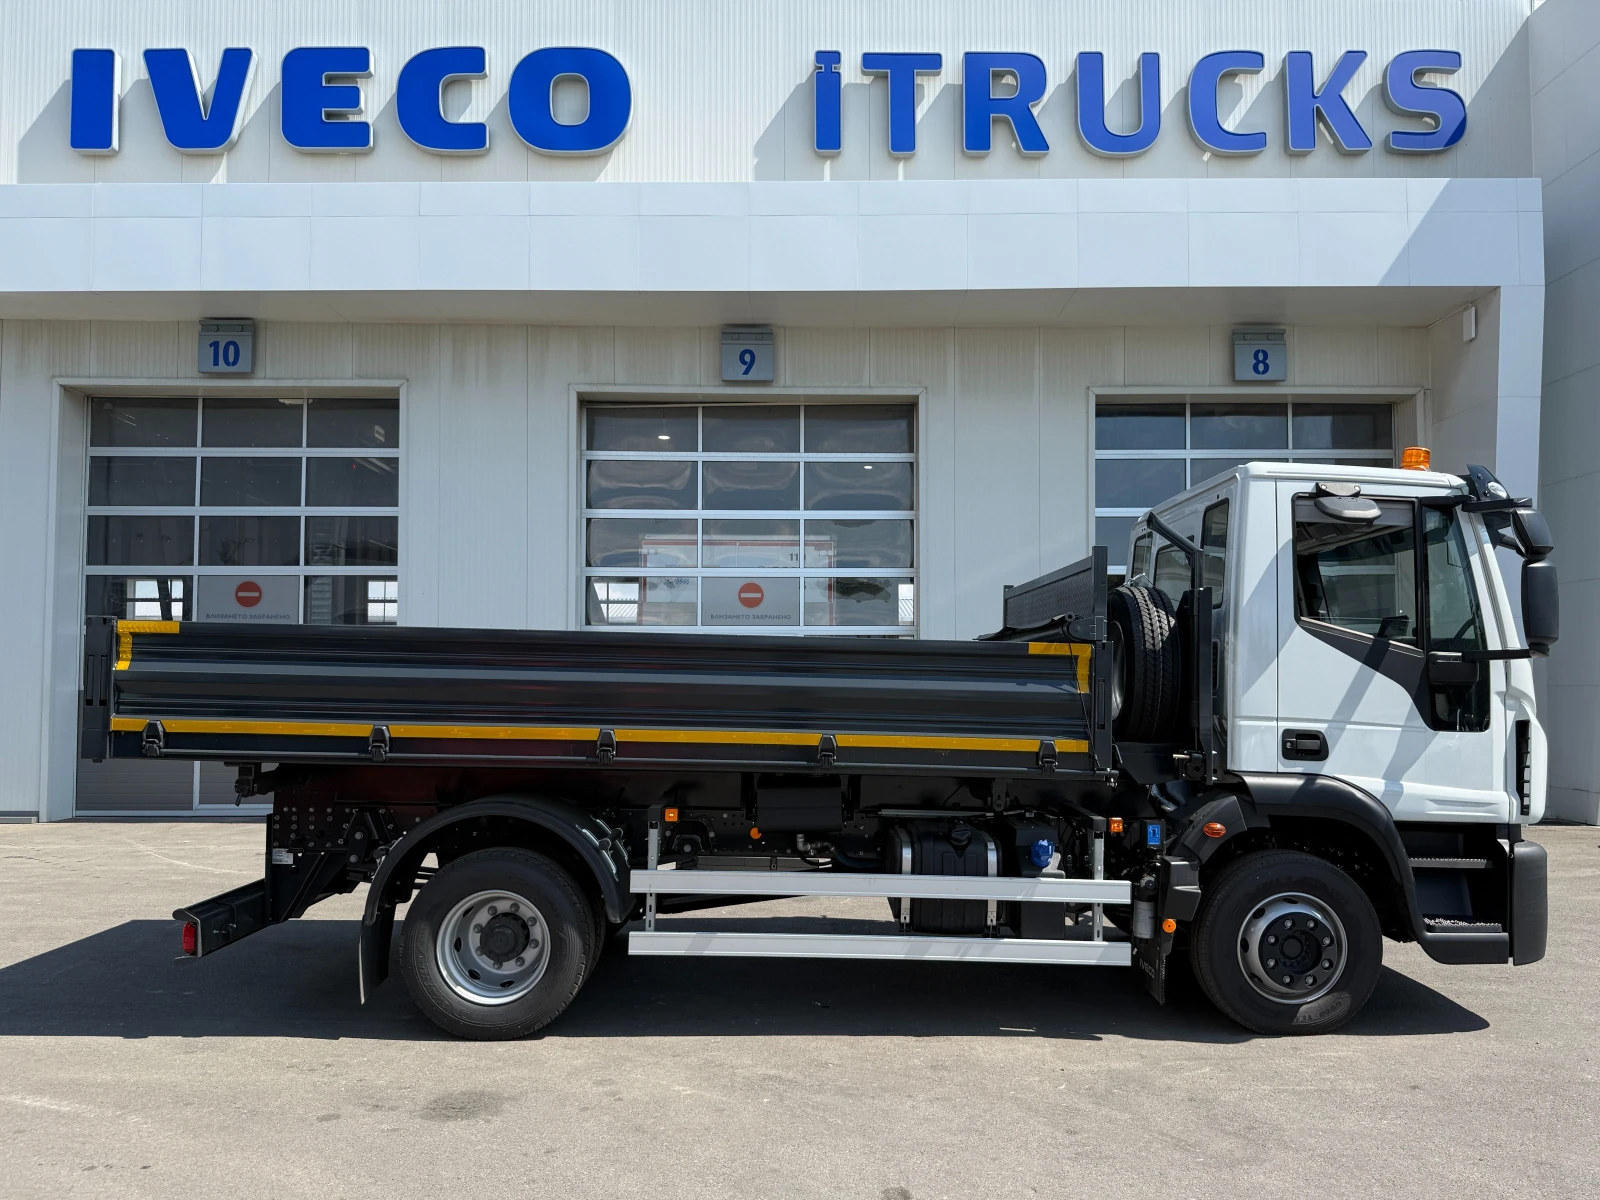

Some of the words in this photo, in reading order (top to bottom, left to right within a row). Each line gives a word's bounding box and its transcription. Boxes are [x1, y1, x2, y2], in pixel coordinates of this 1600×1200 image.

[70, 46, 633, 156] IVECO
[208, 340, 241, 367] 10
[738, 348, 756, 376] 9
[1252, 348, 1270, 376] 8
